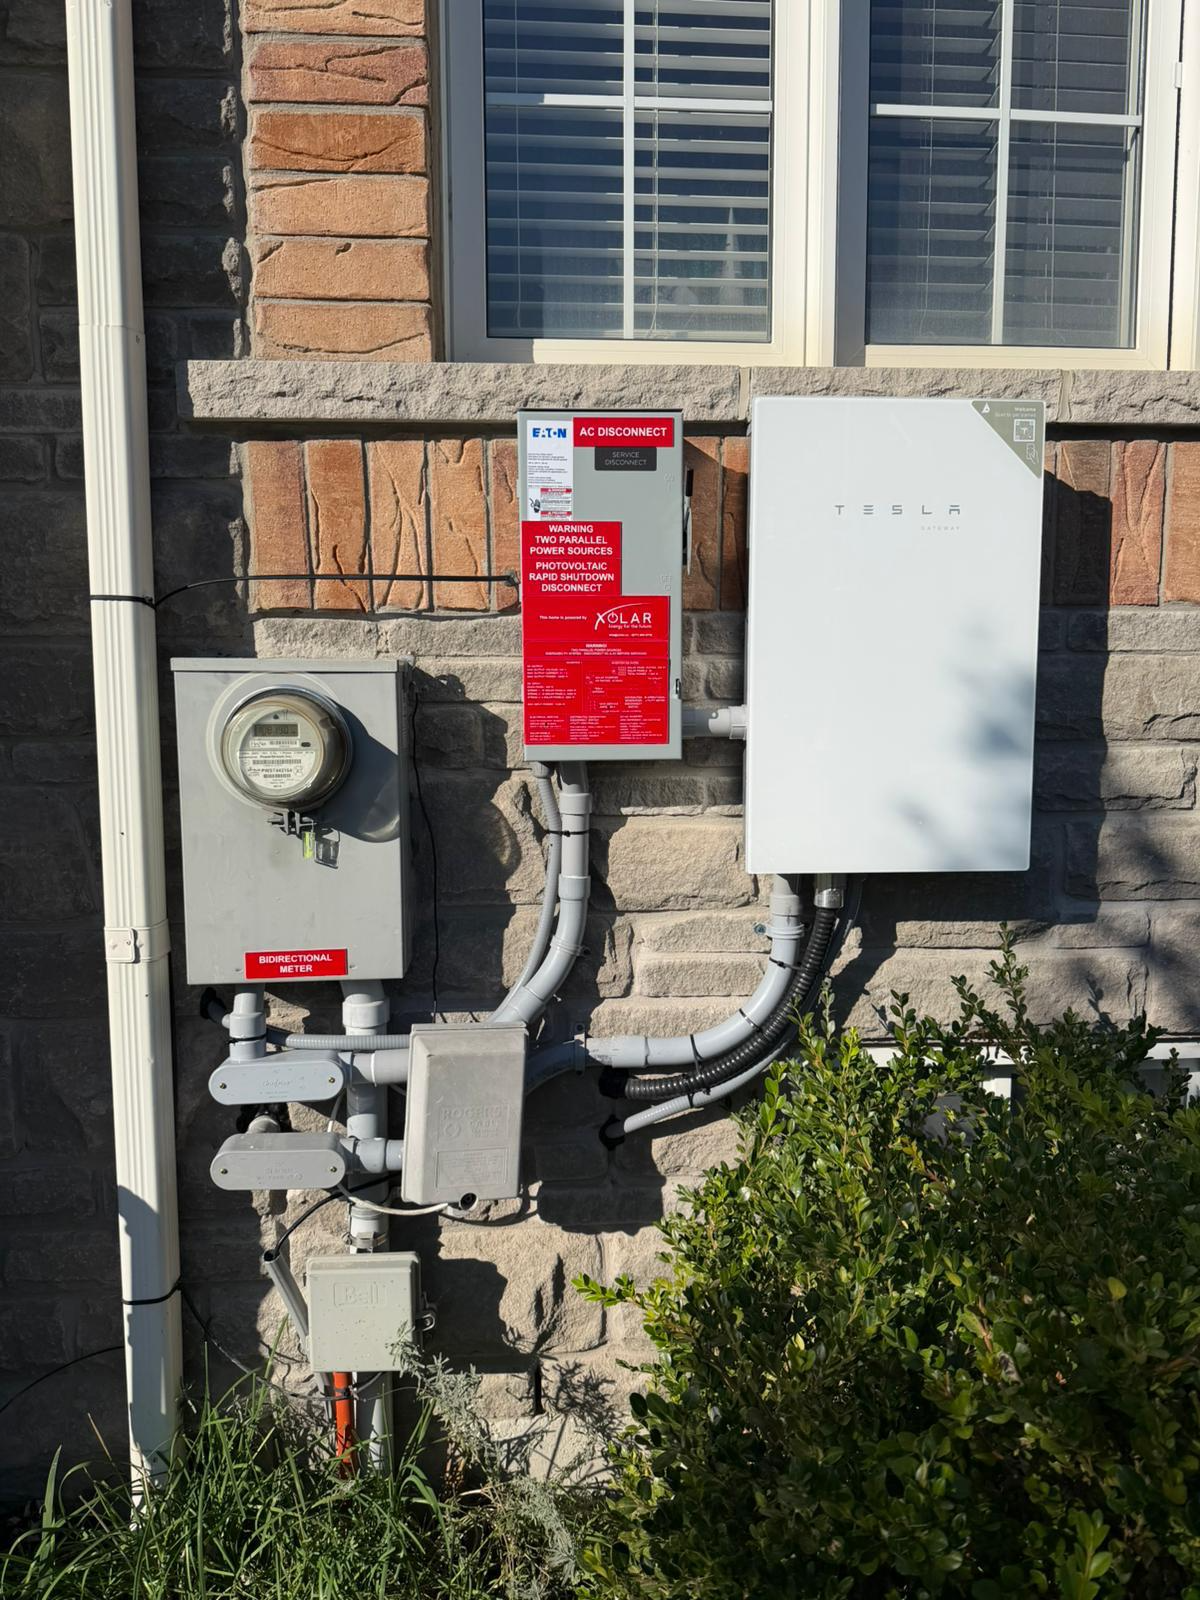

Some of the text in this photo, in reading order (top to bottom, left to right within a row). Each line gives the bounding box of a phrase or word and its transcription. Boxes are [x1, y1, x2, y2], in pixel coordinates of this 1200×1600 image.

[579, 427, 667, 437] AC DISCONNECT
[835, 505, 961, 515] TESLA
[548, 525, 594, 533] WARNING
[535, 536, 608, 544] TWO PARALLEL
[530, 546, 613, 555] POWER SOURCES
[535, 562, 608, 570] PHOTOVOLTAIC
[529, 573, 615, 581] RAPID SHUTDOWN
[541, 583, 602, 592] DISCONNECT
[595, 611, 652, 628] XOLAR
[258, 954, 333, 973] BIDIRECTIONAL METER
[345, 1285, 379, 1305] Bell
